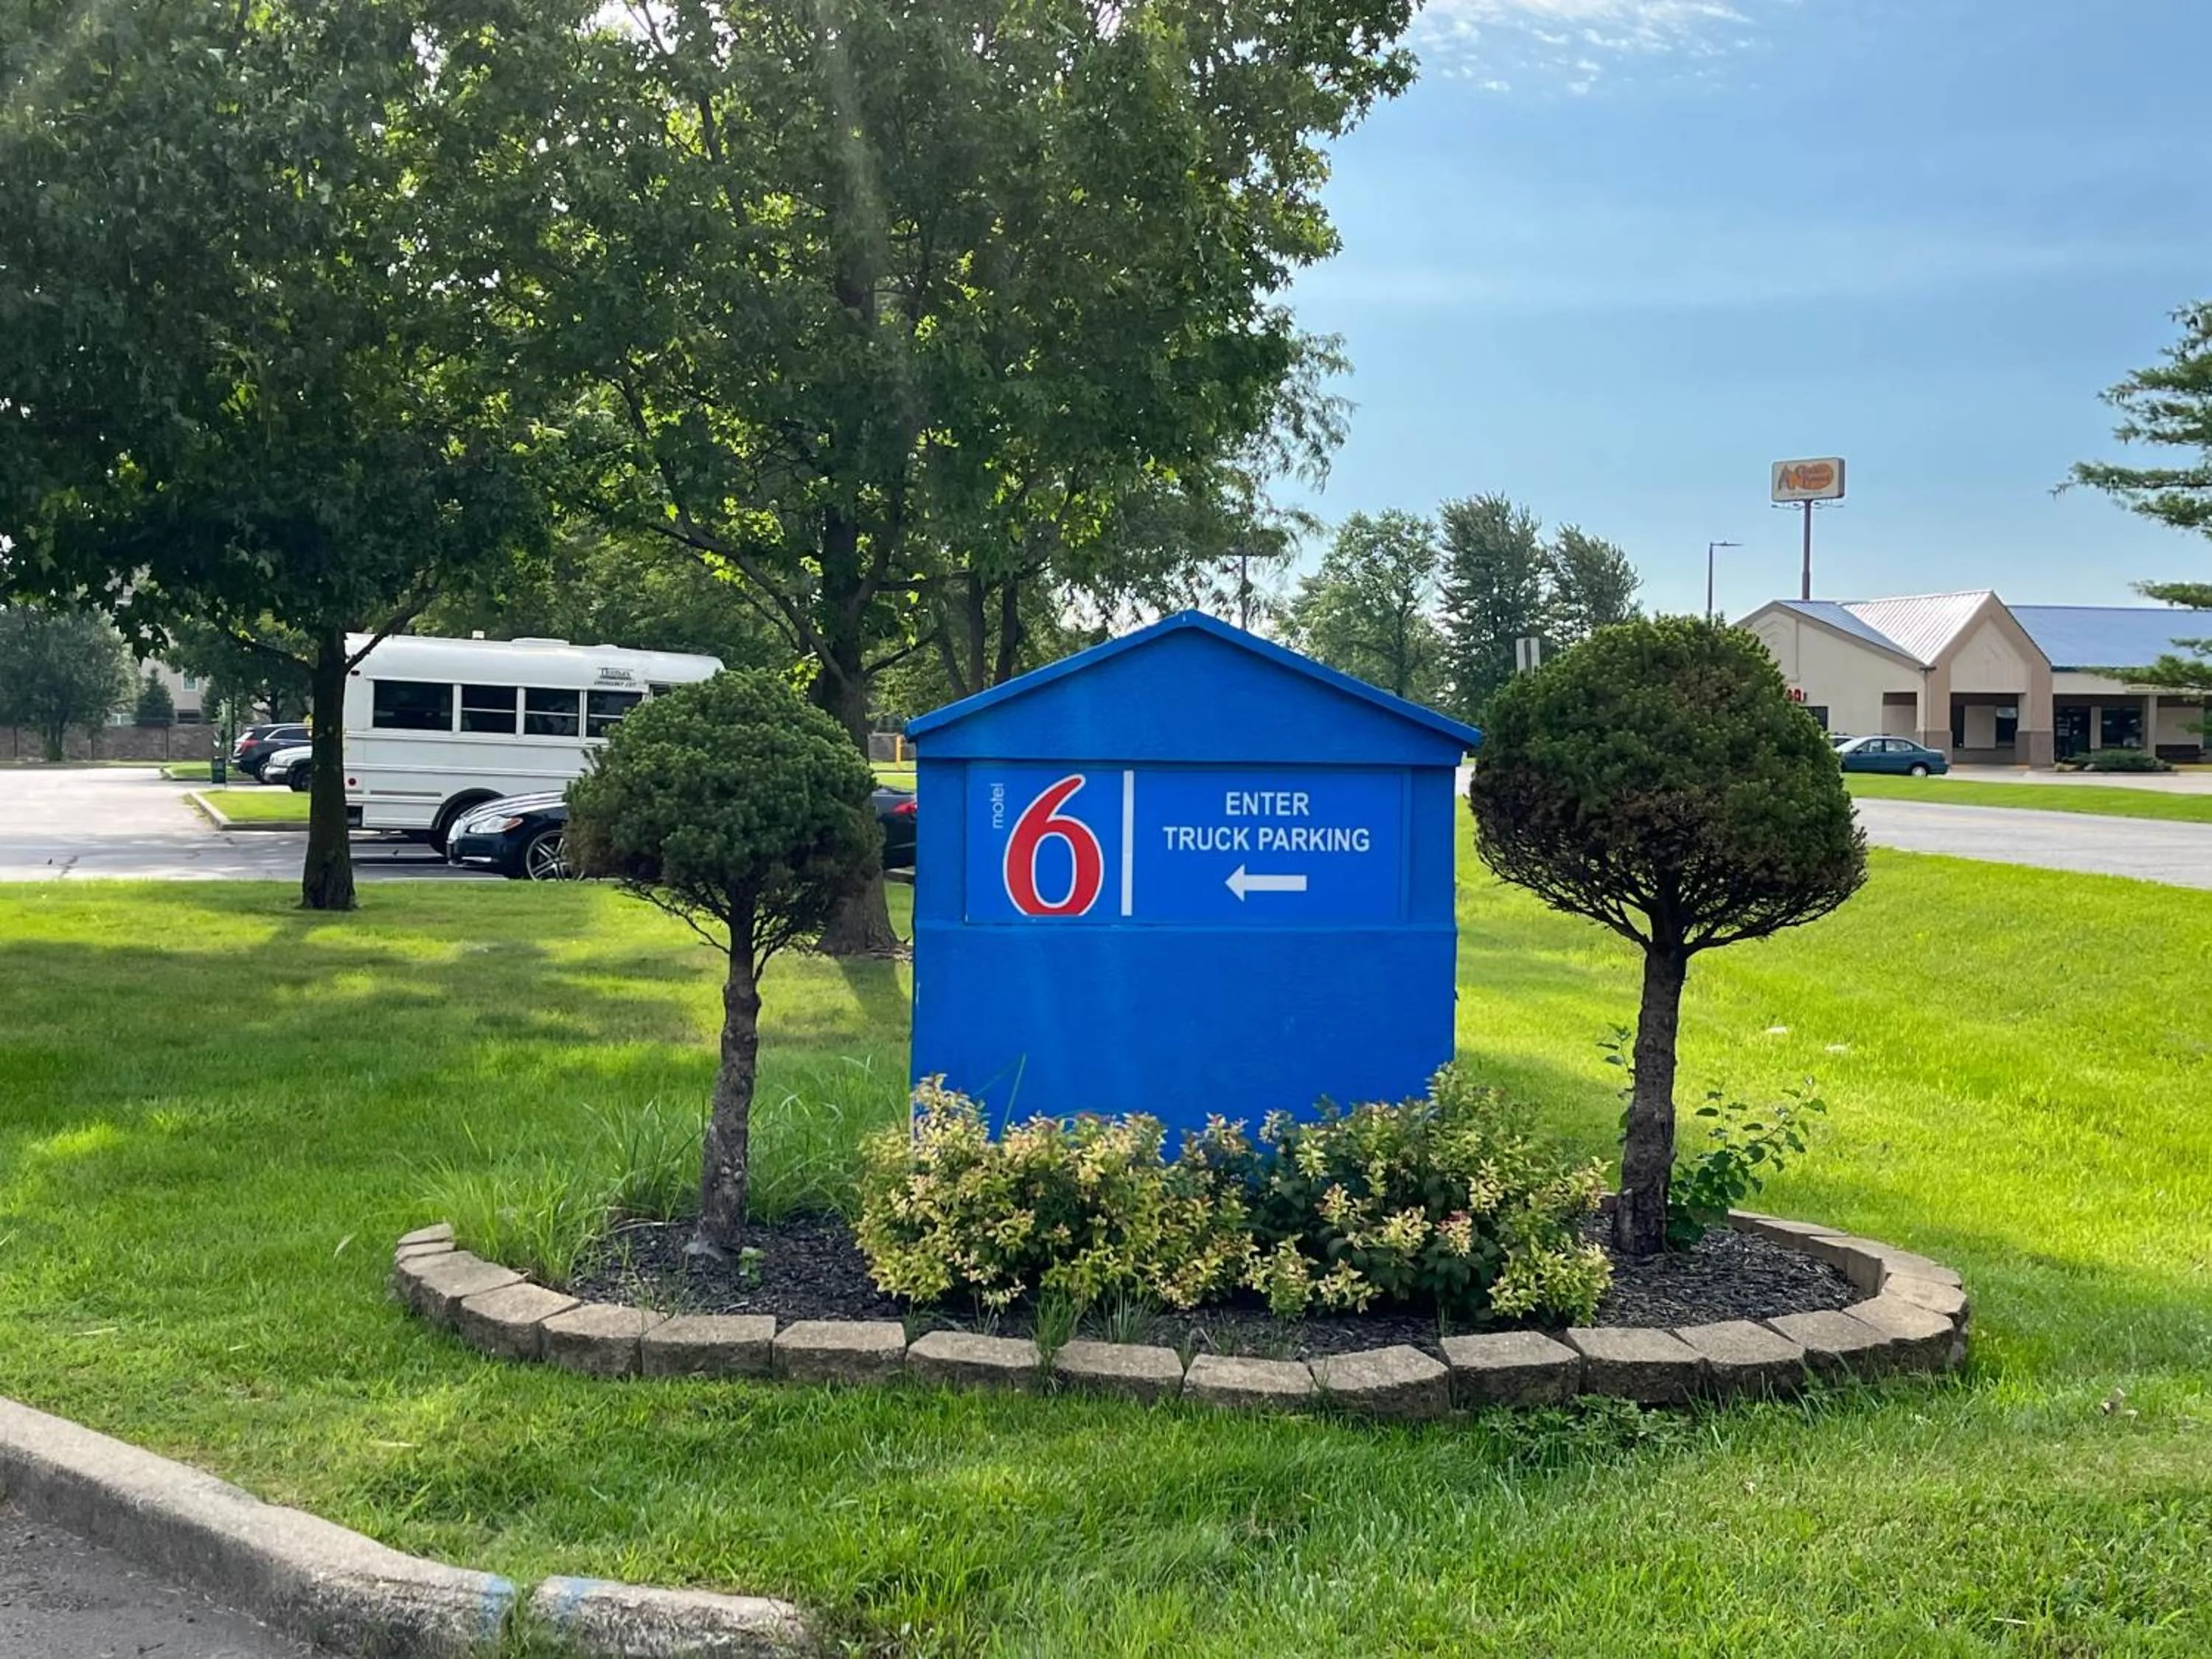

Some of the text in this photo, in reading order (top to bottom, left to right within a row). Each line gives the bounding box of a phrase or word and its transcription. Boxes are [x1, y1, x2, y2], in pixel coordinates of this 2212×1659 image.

[990, 783, 1004, 829] motel
[1225, 791, 1310, 816] ENTER
[1003, 773, 1105, 917] 6
[1163, 827, 1370, 852] TRUCK PARKING
